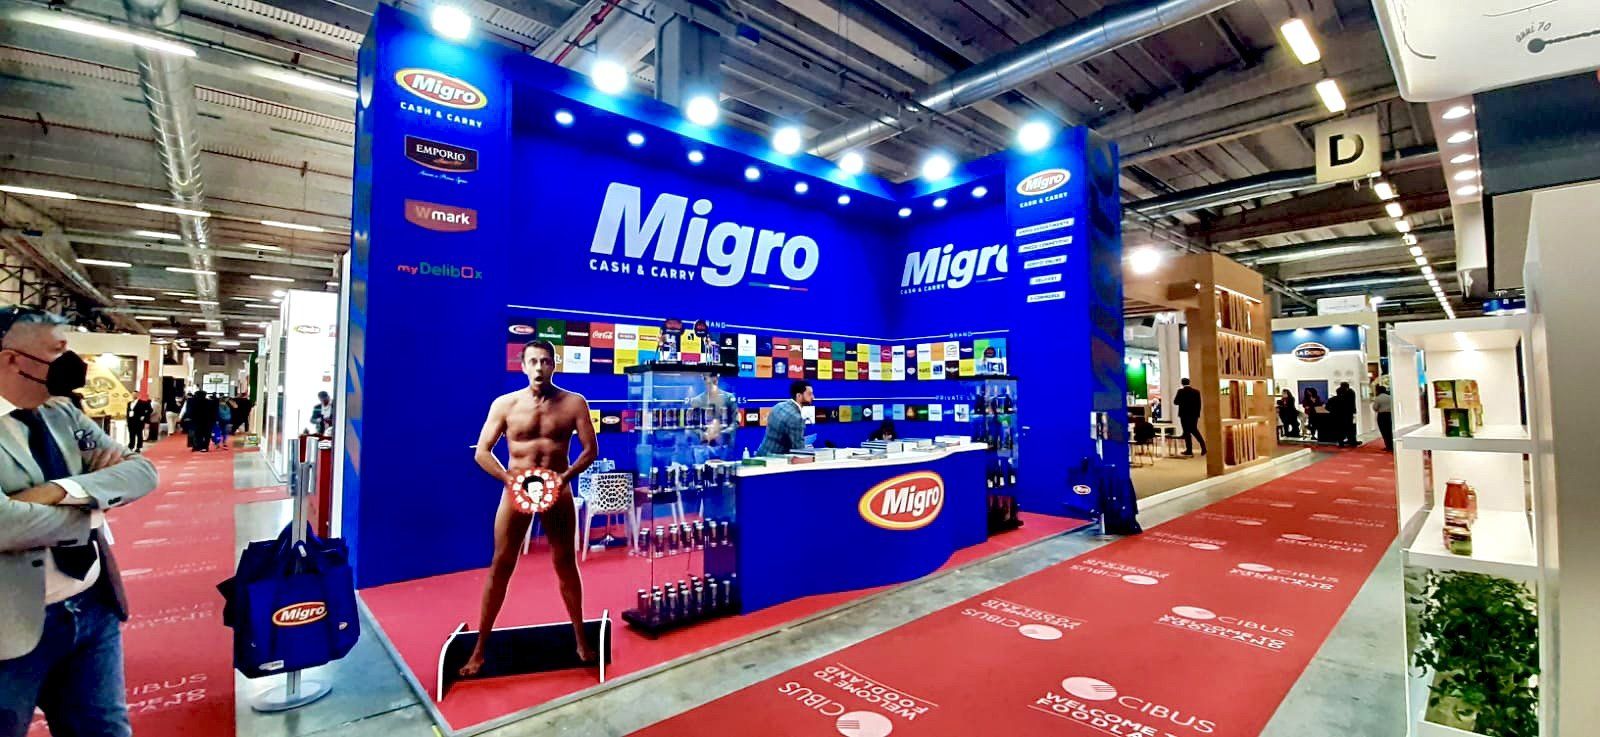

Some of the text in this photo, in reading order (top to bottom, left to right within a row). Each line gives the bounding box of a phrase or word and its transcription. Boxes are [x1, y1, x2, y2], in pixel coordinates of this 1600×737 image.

[1537, 21, 1552, 32] 70
[411, 74, 476, 104] Migro
[400, 101, 482, 128] CASH & CARRY
[415, 144, 466, 162] EMPORIO
[1328, 133, 1364, 167] D
[1025, 174, 1064, 191] Migro
[415, 205, 470, 225] Wmark
[590, 182, 819, 287] Migro
[589, 258, 696, 281] CASH & CARRY
[881, 485, 940, 517] Migro
[280, 604, 327, 622] Migro
[961, 608, 1021, 628] CIBUS
[1217, 616, 1296, 637] CIBUS
[778, 681, 845, 716] CIBUS
[813, 670, 917, 721] WELCOME TO
[825, 665, 929, 714] FOODLAND
[1046, 692, 1158, 737] WELCOME
[1117, 695, 1217, 734] CIBUS
